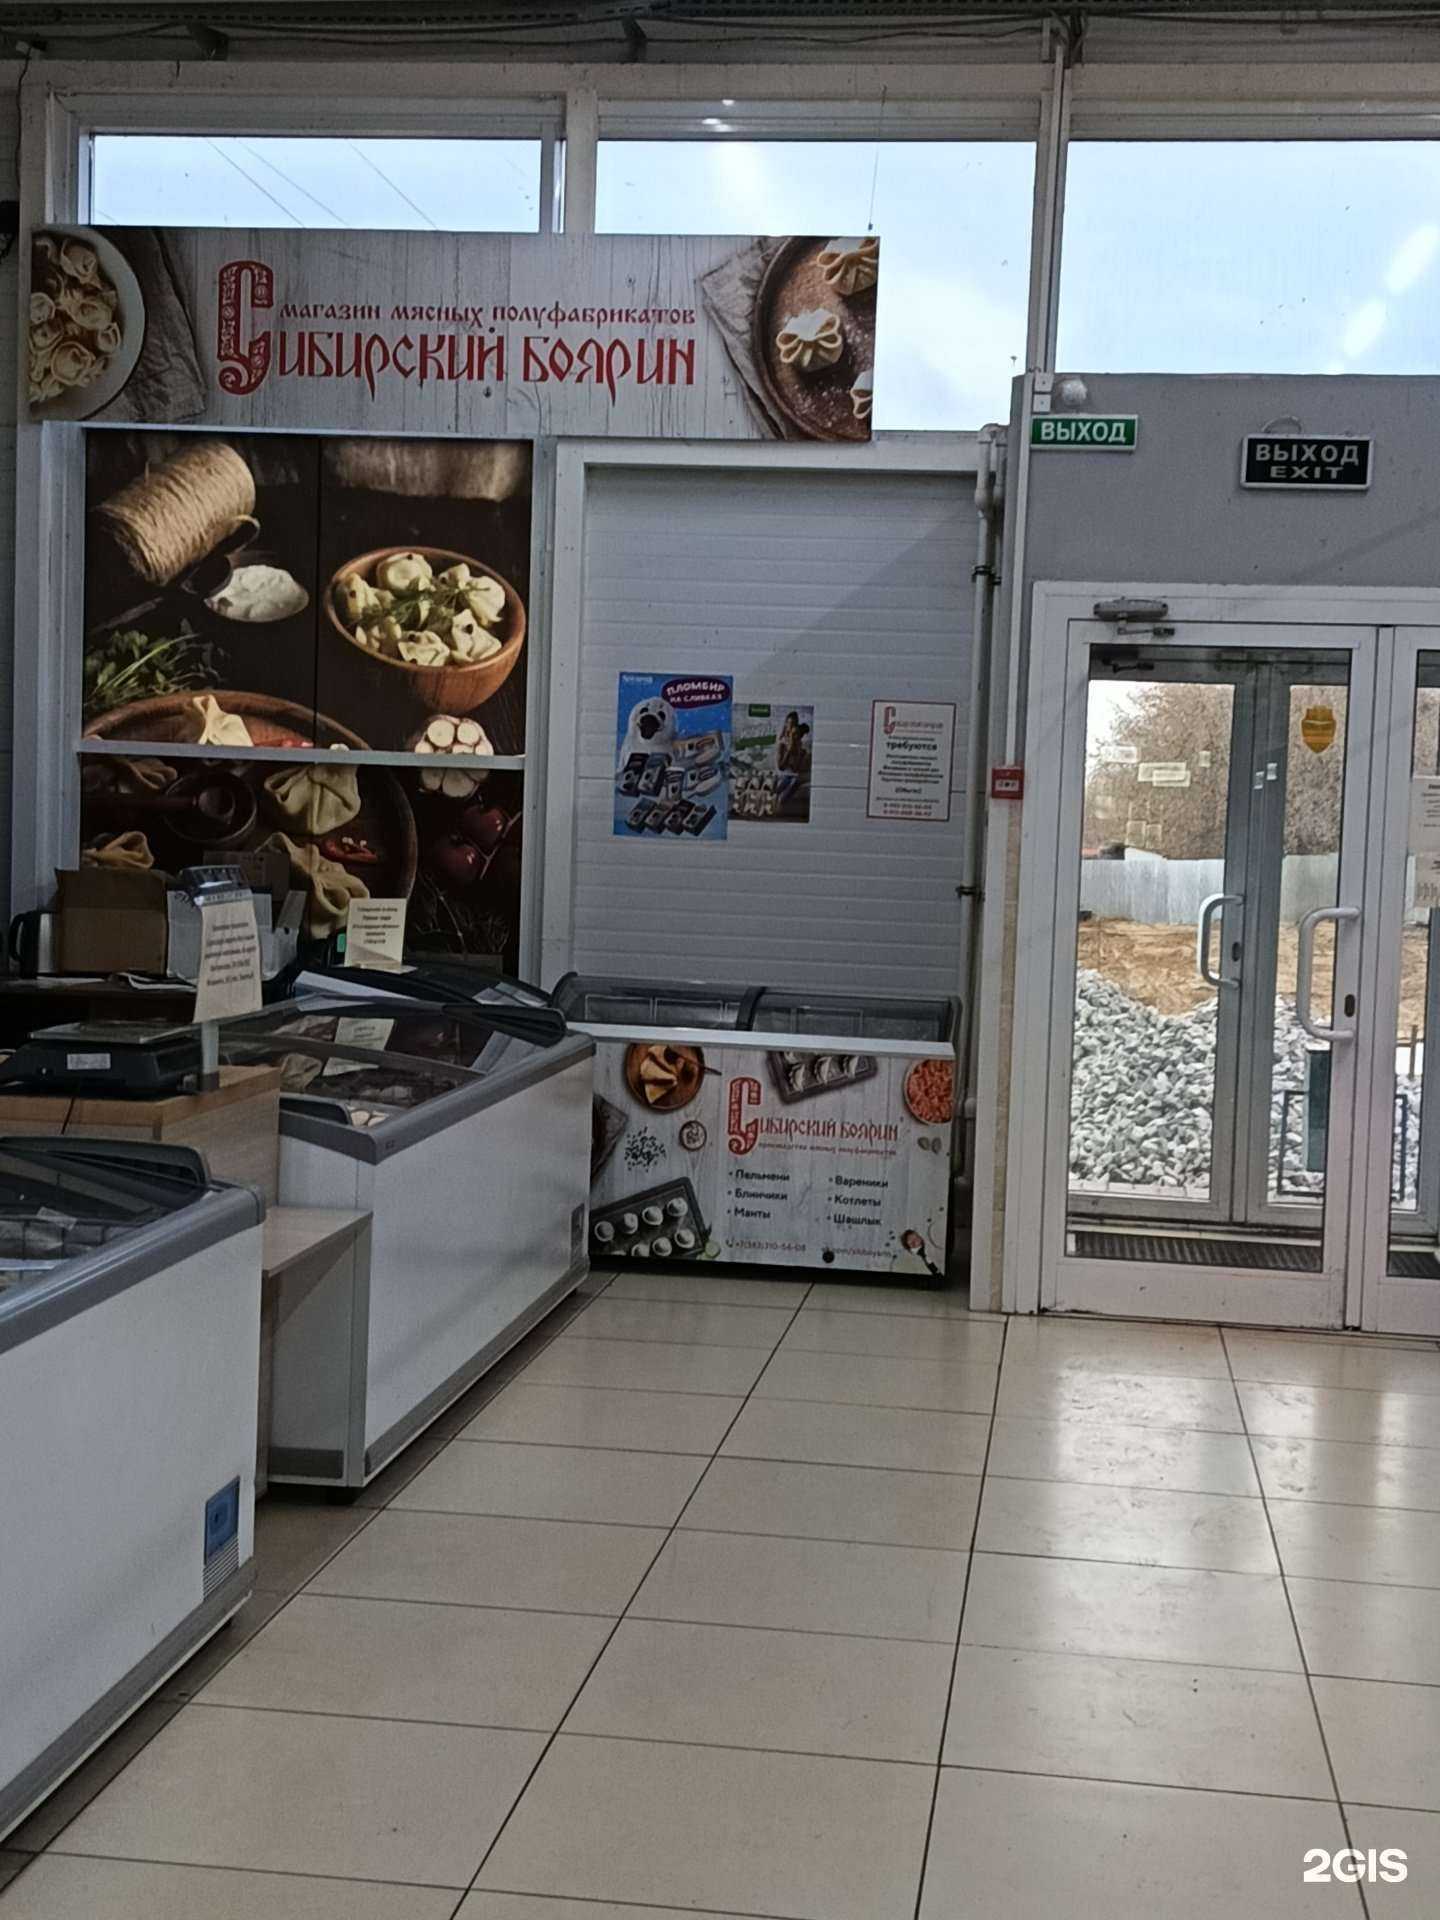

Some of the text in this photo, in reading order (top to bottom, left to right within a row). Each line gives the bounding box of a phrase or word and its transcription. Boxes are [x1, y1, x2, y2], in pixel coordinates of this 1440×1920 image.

[279, 301, 696, 329] магазин мясных полуфабрикатов
[1041, 422, 1127, 443] ВЫХОД
[1256, 444, 1360, 466] ВЫХОД
[1270, 466, 1344, 480] EXIT
[667, 681, 725, 696] ПЛОМБИР
[735, 1168, 790, 1181] Пельмени
[835, 1175, 889, 1188] Вареники
[735, 1187, 788, 1200] Блинчики
[834, 1195, 882, 1206] Котлеты
[734, 1207, 771, 1219] Манты
[833, 1213, 882, 1225] Шашлык
